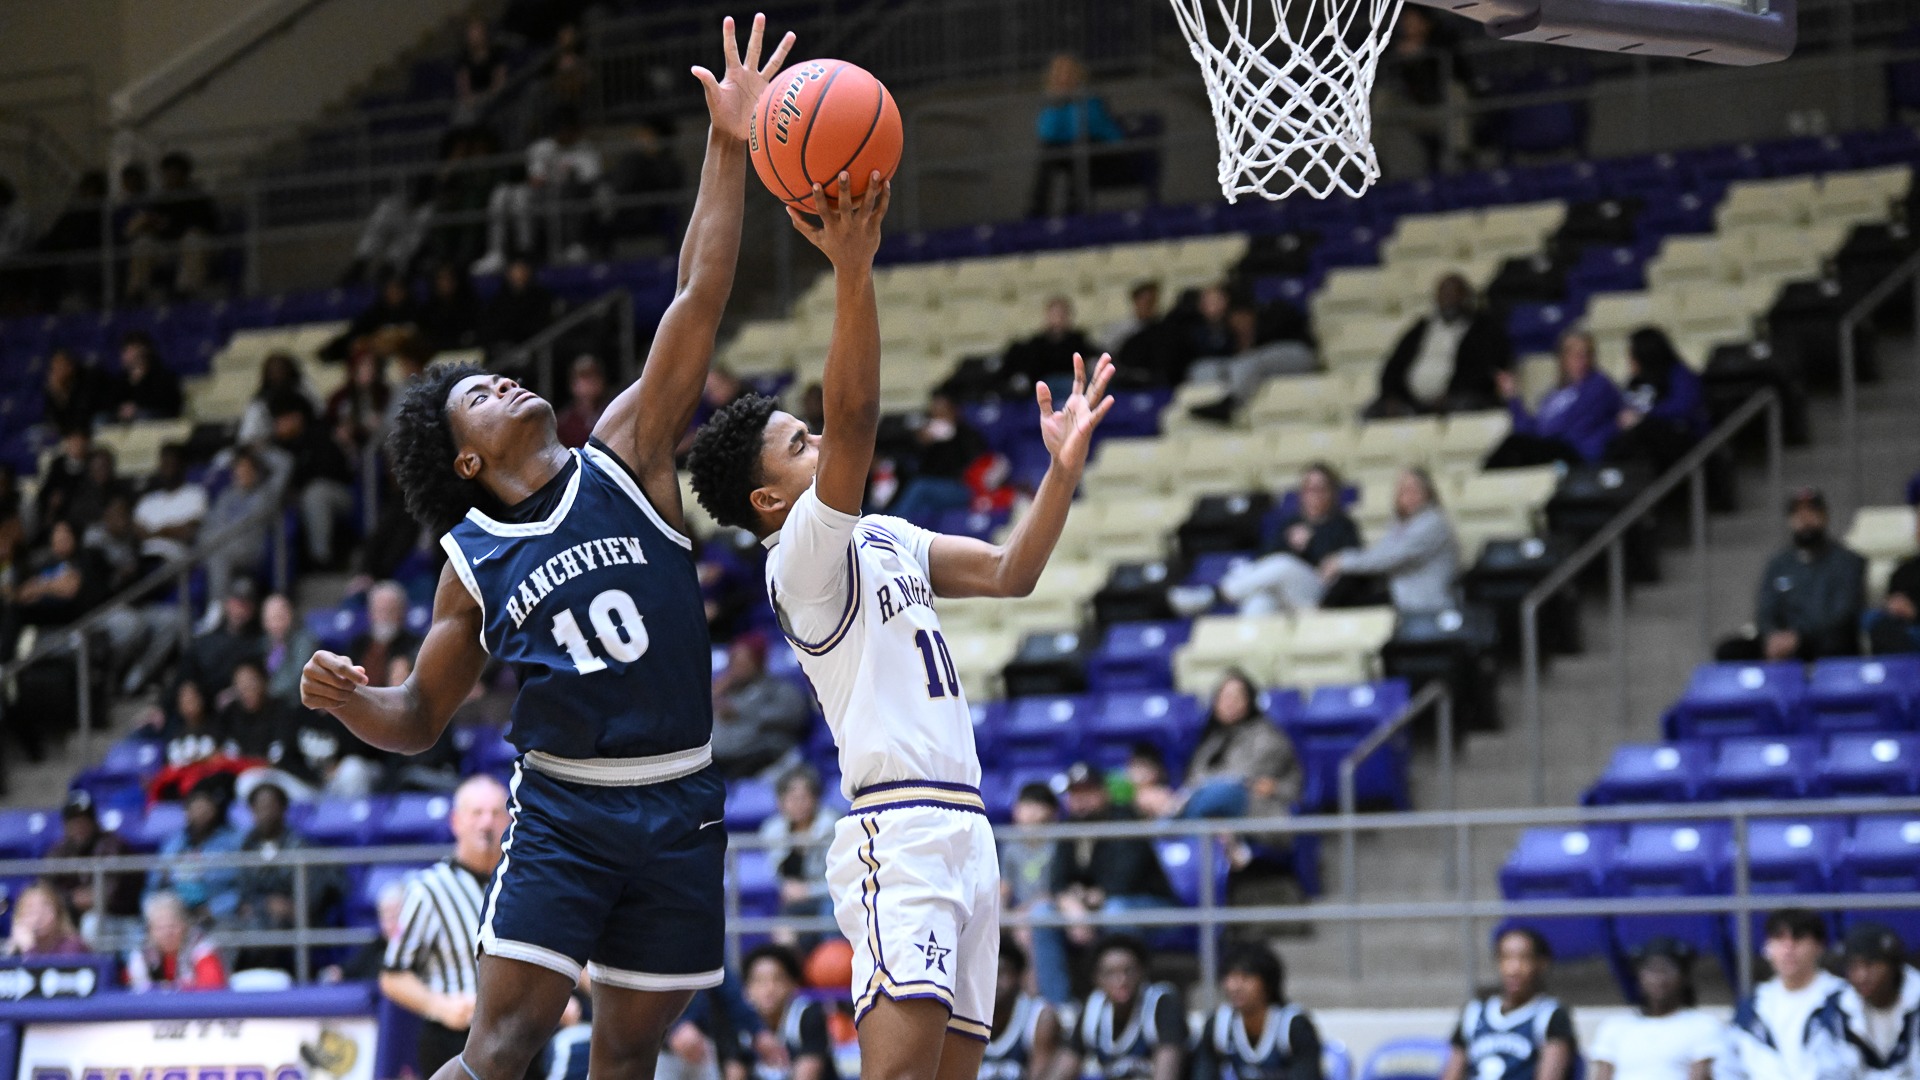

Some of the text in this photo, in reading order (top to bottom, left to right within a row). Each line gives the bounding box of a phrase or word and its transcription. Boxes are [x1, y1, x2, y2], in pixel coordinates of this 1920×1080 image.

[775, 62, 826, 145] Baden
[506, 537, 648, 630] RANCHVIEW
[551, 589, 649, 675] 10
[912, 628, 959, 700] 10
